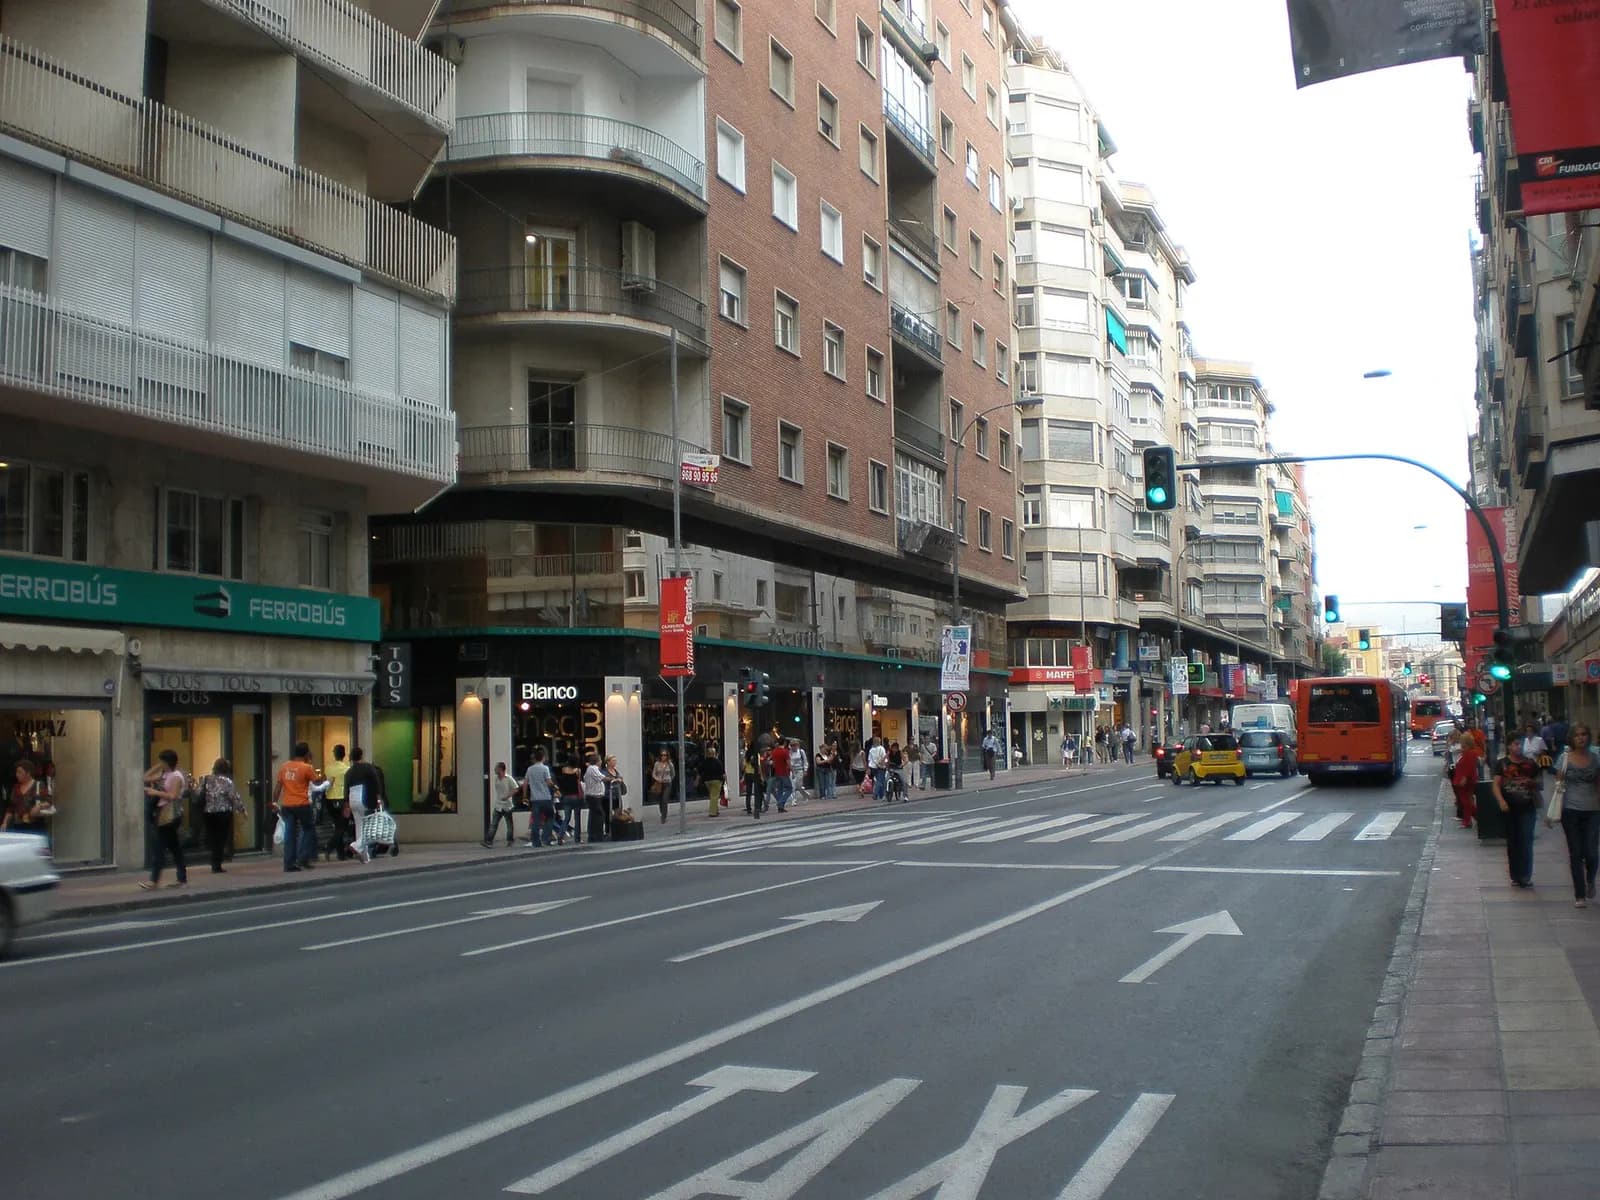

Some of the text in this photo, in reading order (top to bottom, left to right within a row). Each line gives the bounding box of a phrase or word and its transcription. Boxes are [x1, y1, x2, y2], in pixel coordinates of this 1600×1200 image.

[693, 471, 701, 482] 90
[1503, 507, 1518, 564] Grande
[0, 573, 118, 606] ERROBÚS
[249, 599, 346, 626] FERROBÚS
[684, 578, 695, 676] semana Grande
[159, 674, 364, 693] TOUS TOUS TOUS TOUS
[387, 647, 403, 704] TOUS
[171, 690, 210, 705] TOUS
[522, 683, 577, 700] Blanco
[501, 1065, 1177, 1200] TAXI
